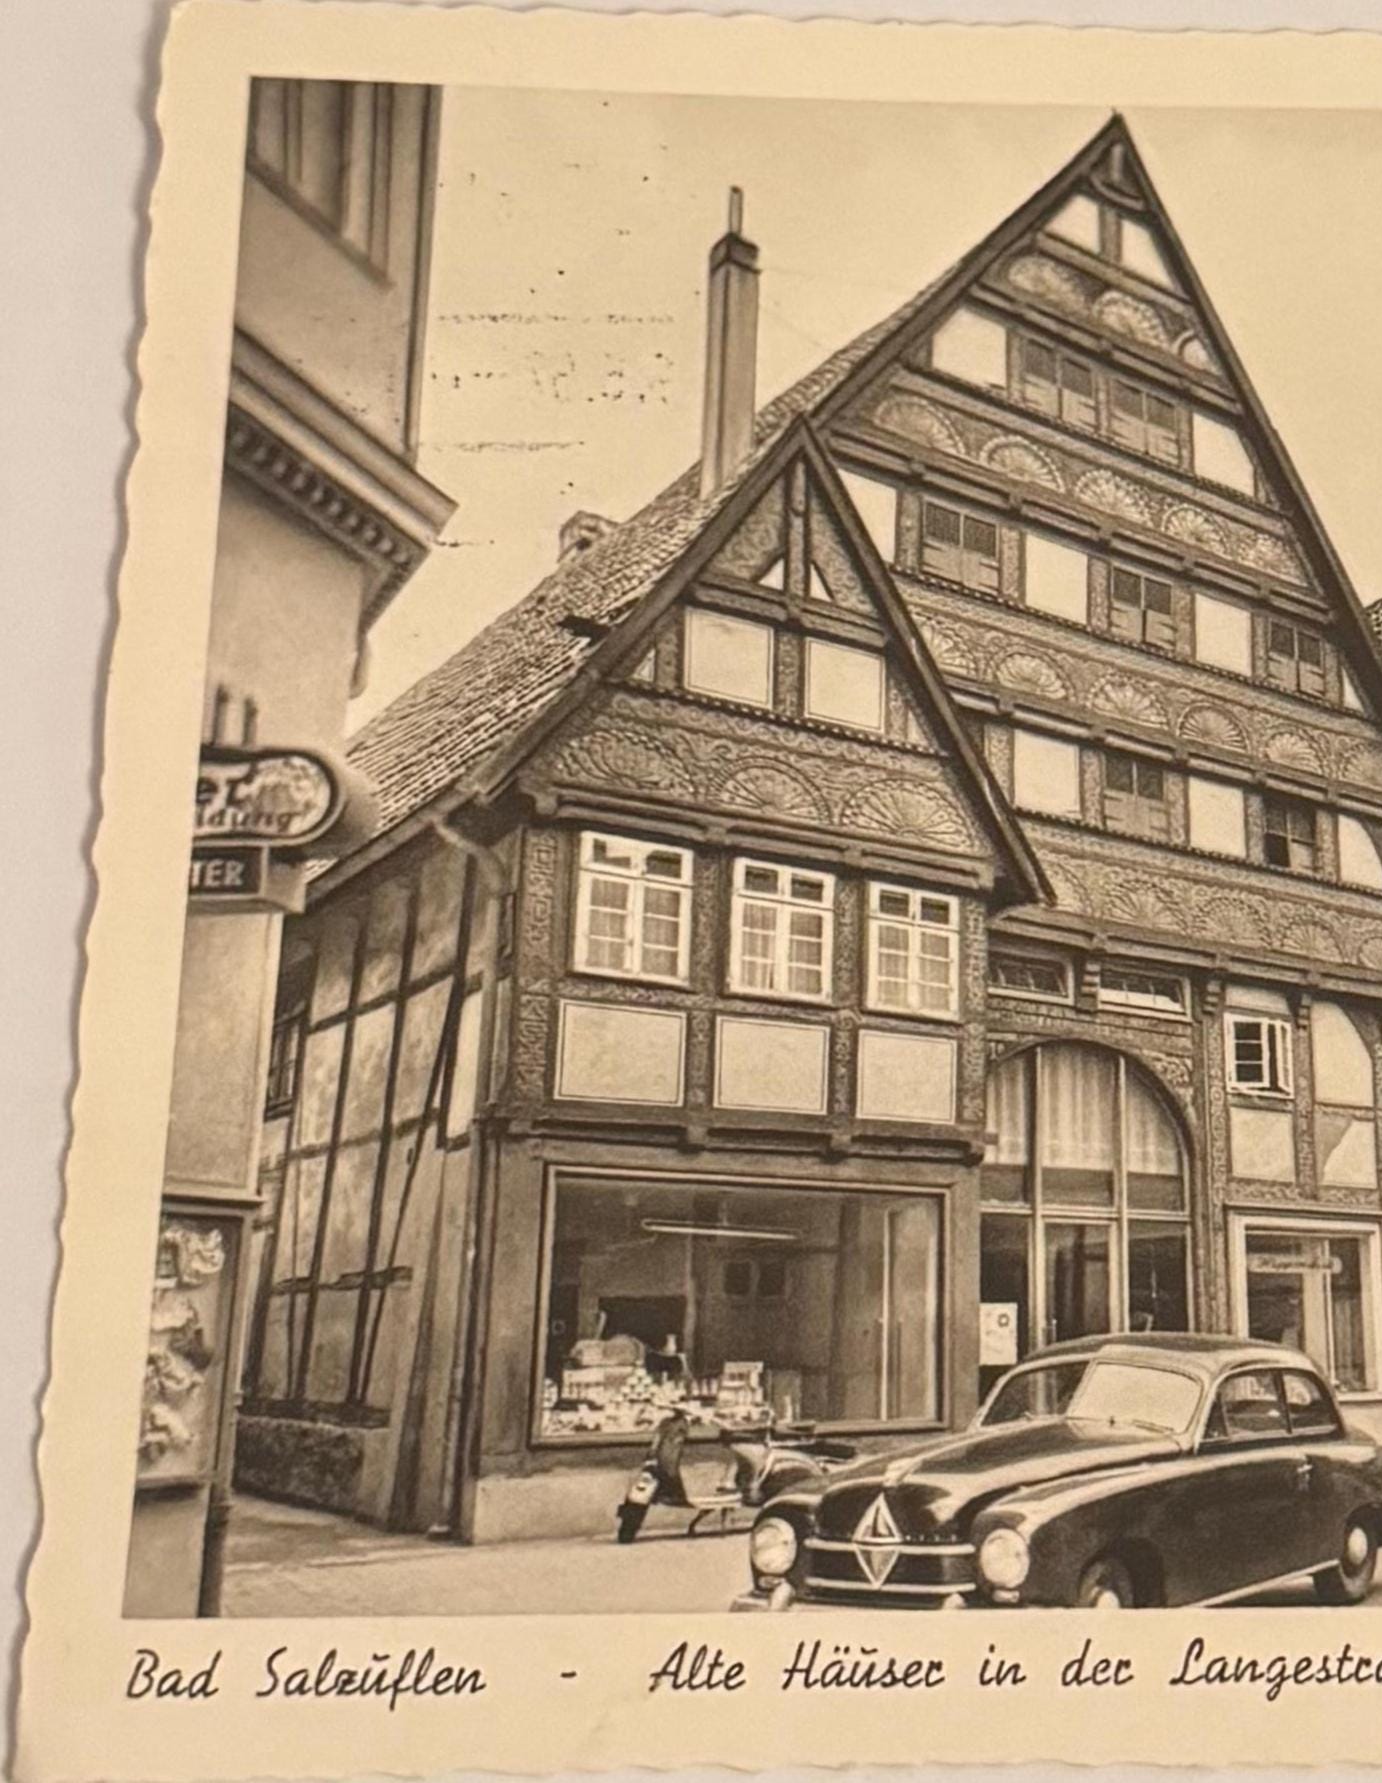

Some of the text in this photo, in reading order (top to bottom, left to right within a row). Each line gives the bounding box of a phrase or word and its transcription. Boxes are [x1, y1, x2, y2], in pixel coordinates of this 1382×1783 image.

[125, 1648, 222, 1700] Bad
[648, 1641, 747, 1693] Alte
[978, 1642, 1027, 1687] in
[1061, 1639, 1135, 1687] der
